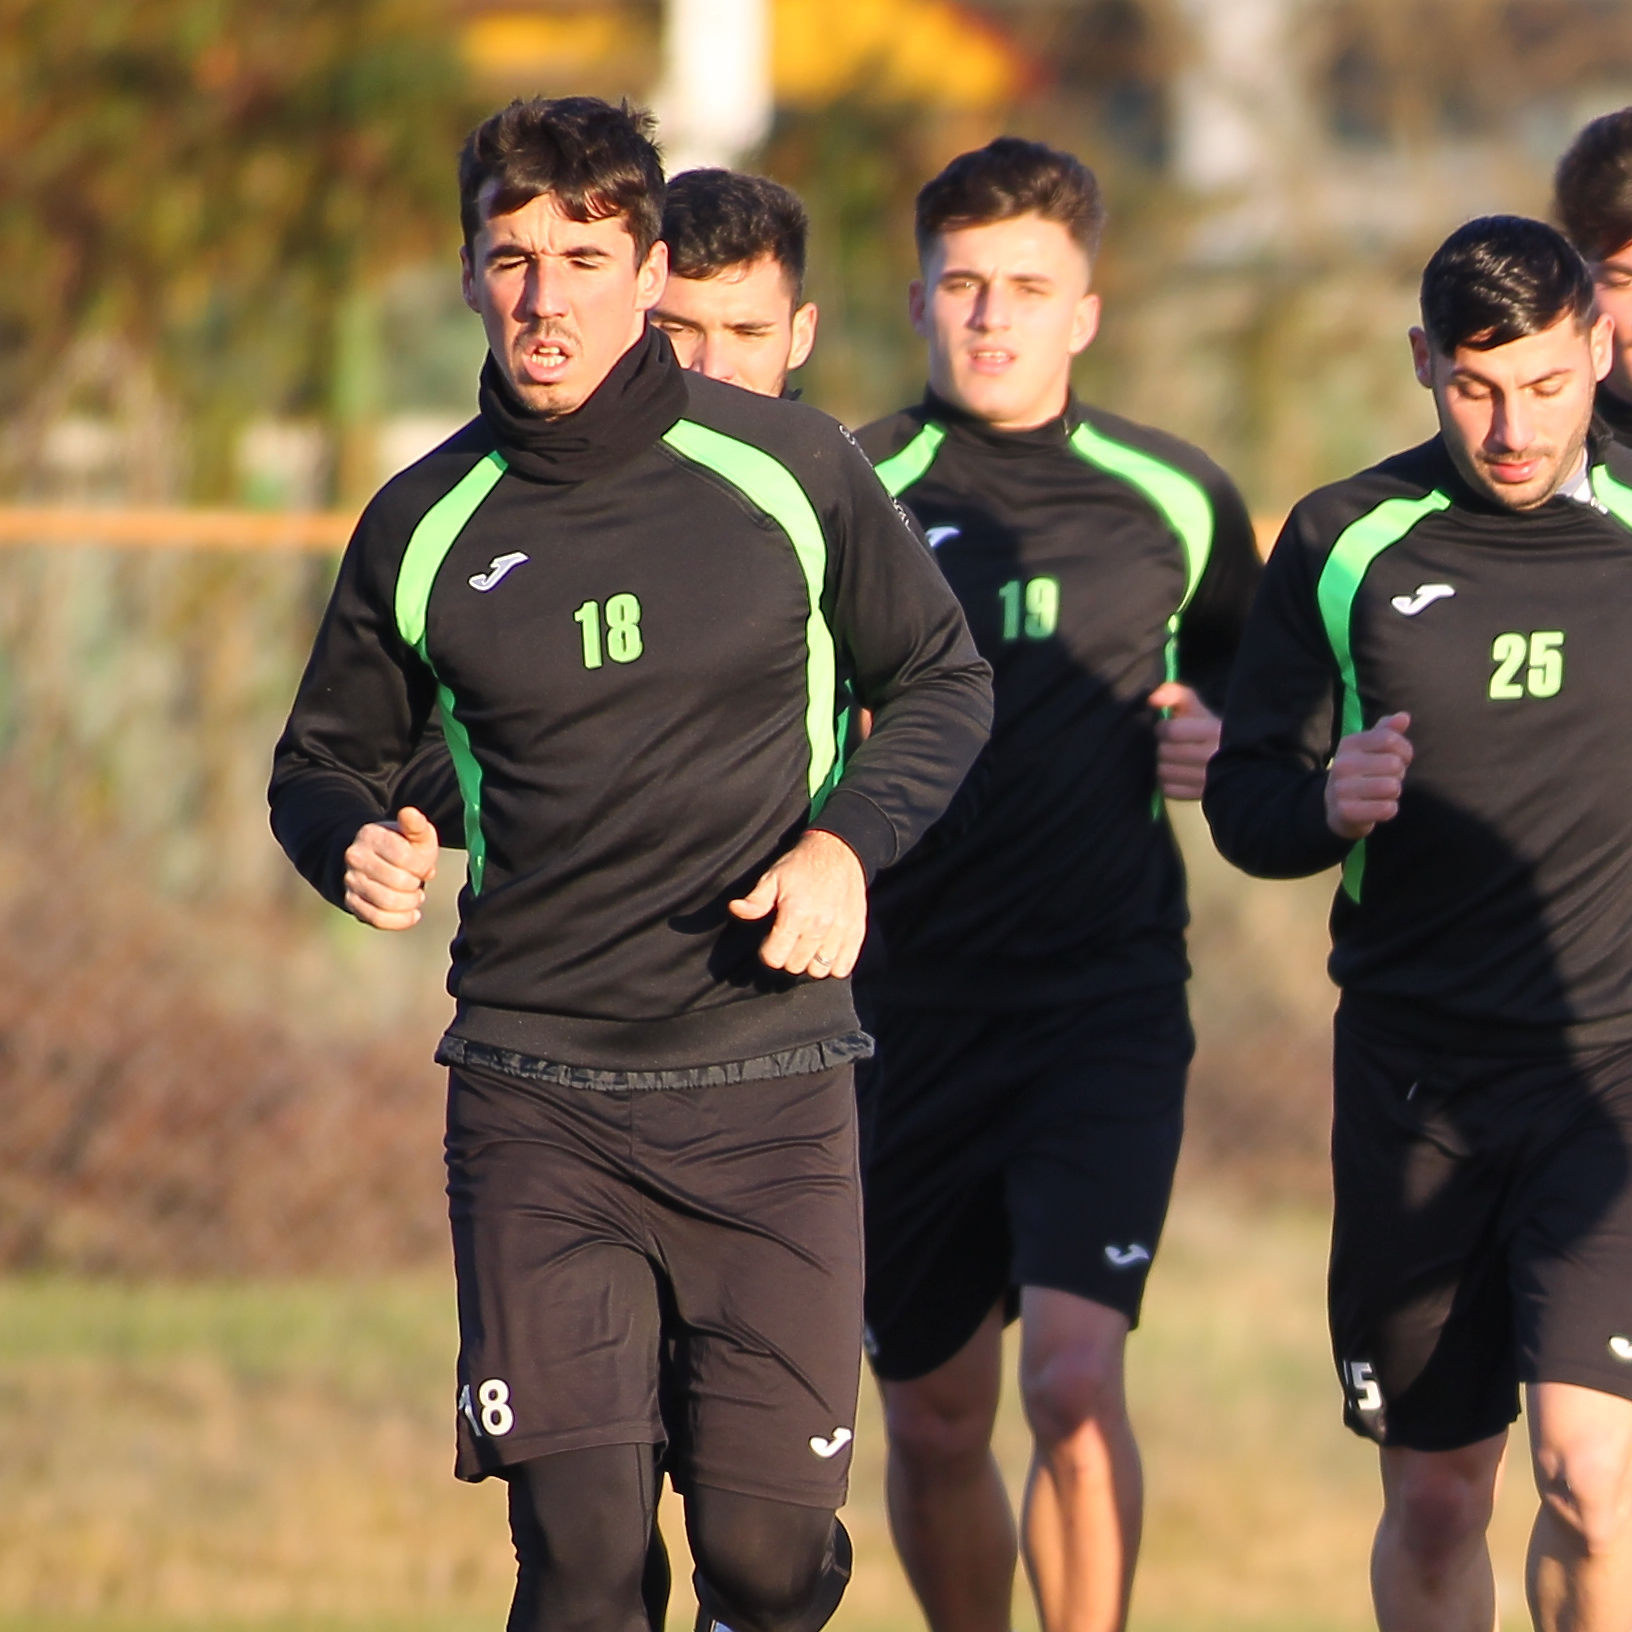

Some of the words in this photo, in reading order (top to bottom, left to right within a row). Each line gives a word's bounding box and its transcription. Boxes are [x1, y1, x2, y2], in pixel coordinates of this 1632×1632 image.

[573, 593, 644, 670] 18
[998, 576, 1059, 641] 19
[1489, 631, 1565, 700] 25
[1344, 1360, 1383, 1410] 5
